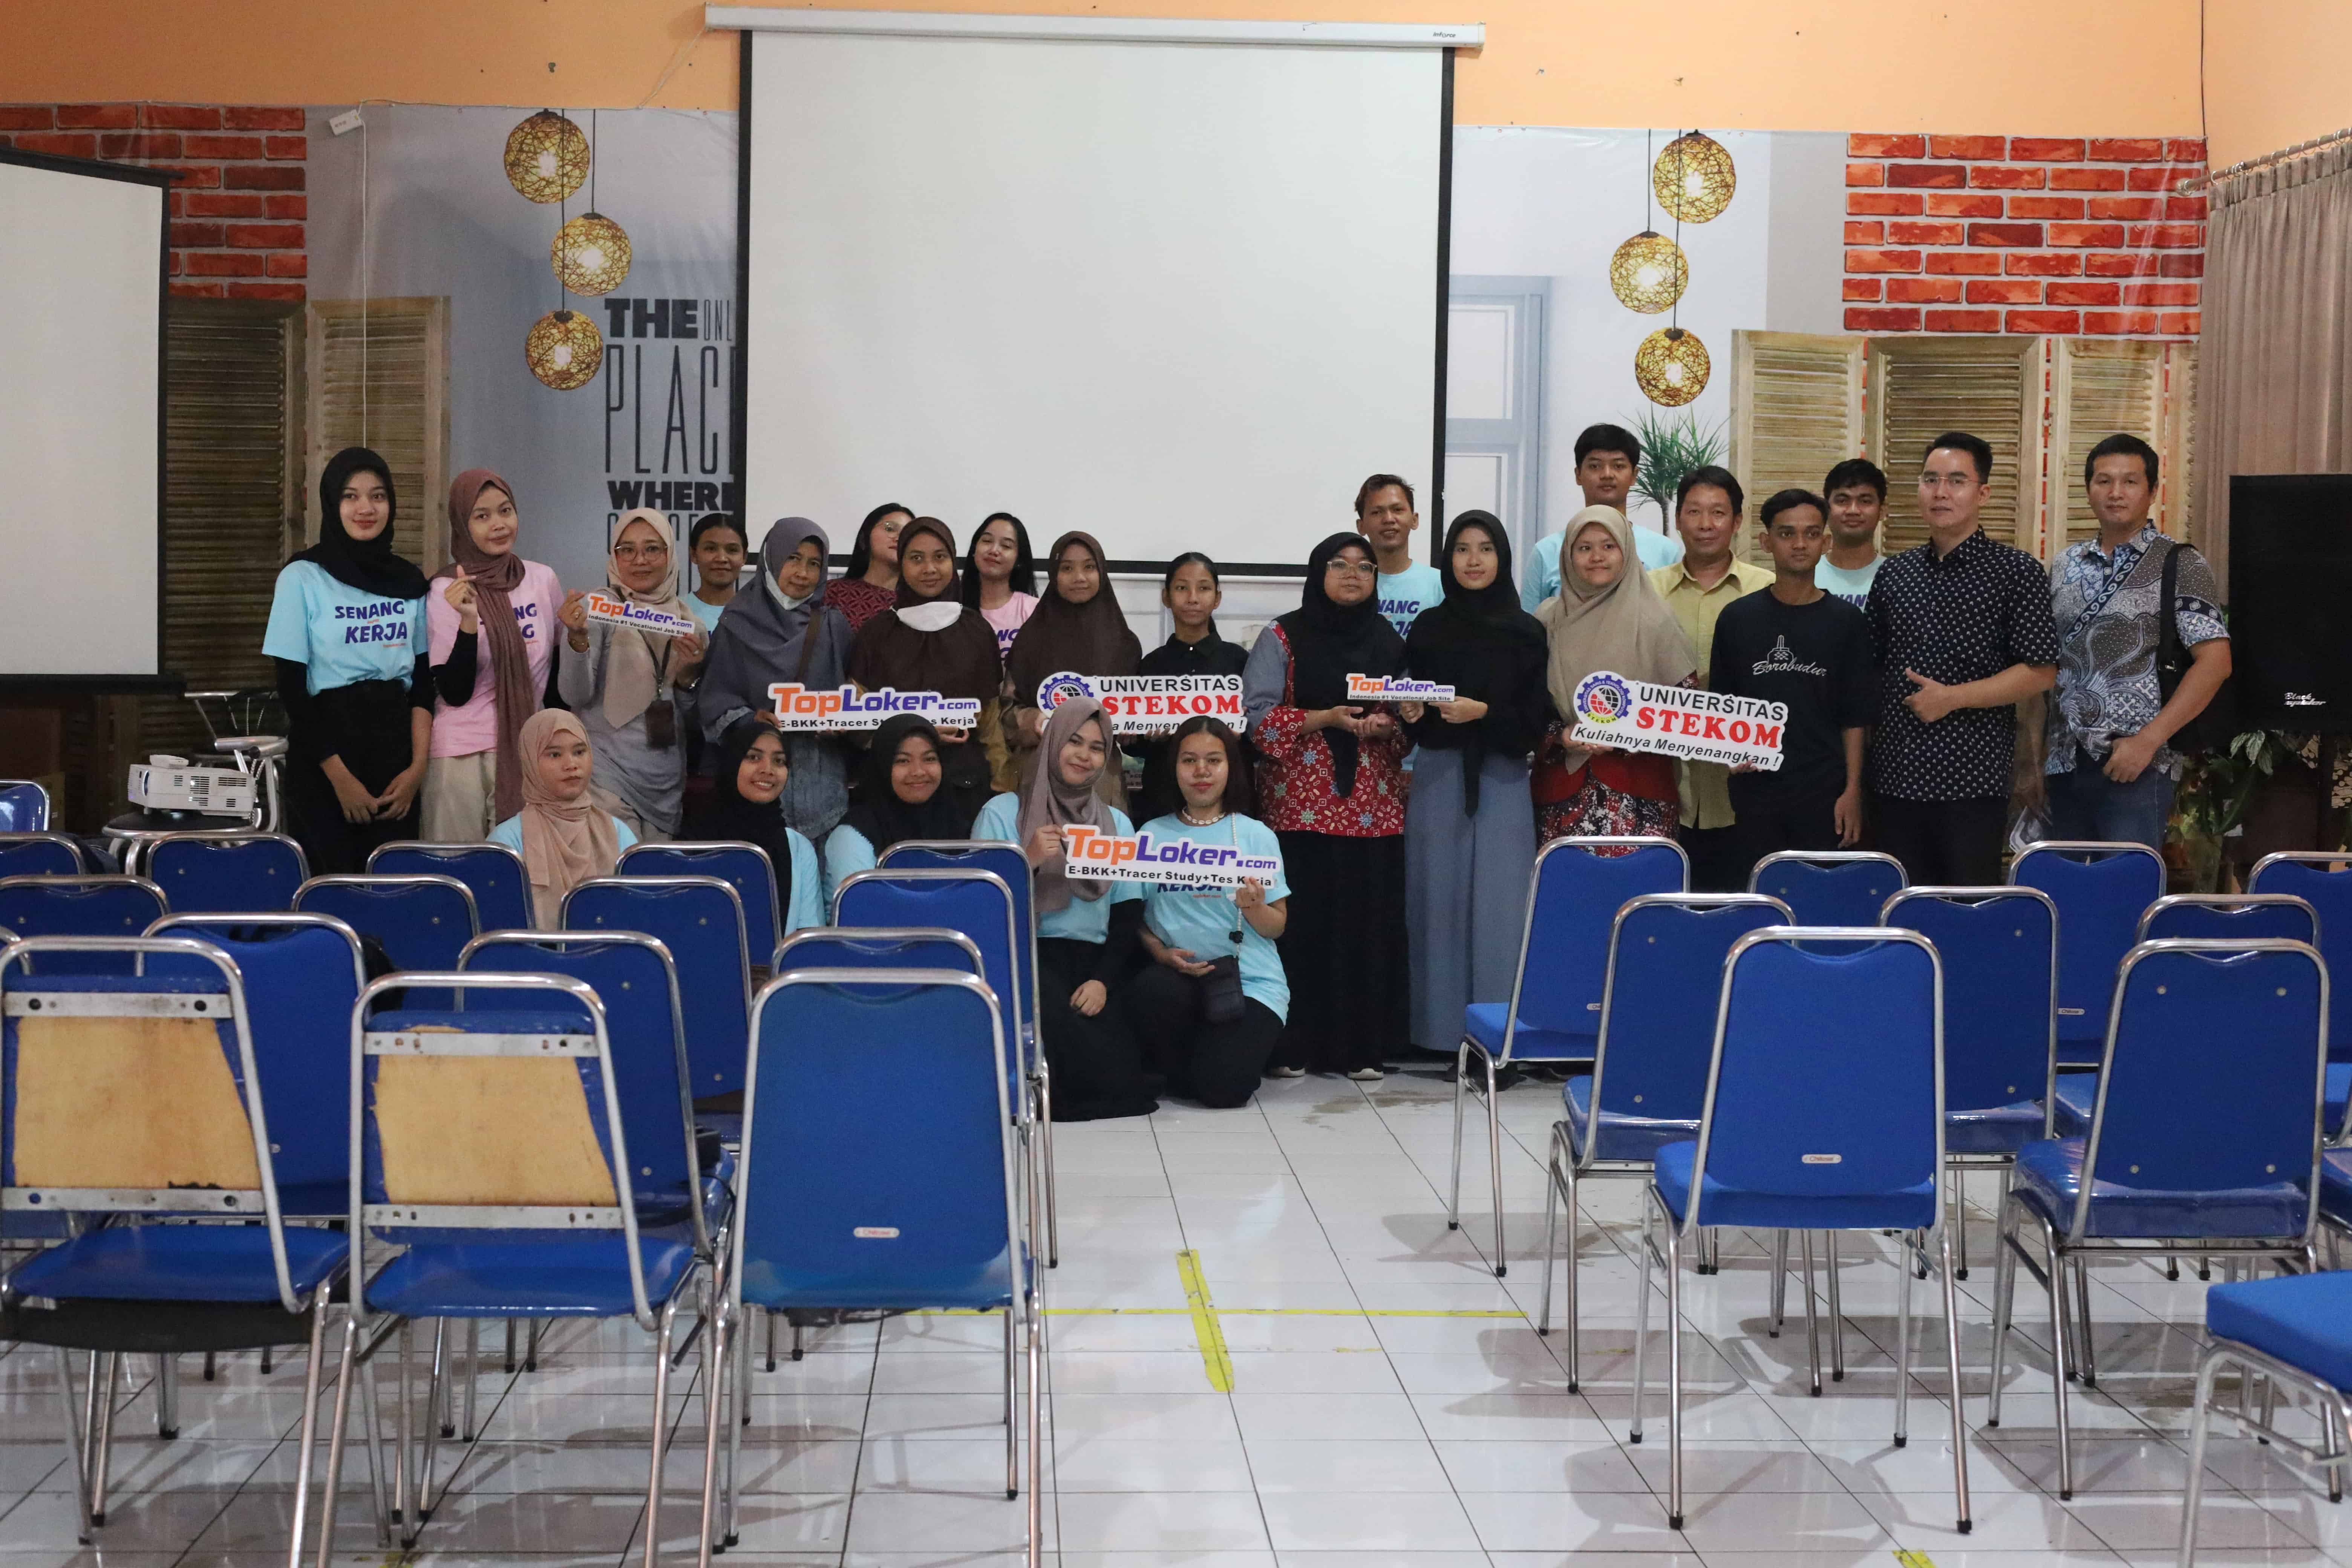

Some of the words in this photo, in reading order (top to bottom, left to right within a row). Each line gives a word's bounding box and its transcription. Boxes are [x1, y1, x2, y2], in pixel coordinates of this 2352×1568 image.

[605, 298, 697, 338] THE
[704, 299, 732, 341] ONL
[335, 600, 404, 620] SENANG
[590, 596, 692, 628] TopLoker.com
[1378, 599, 1420, 614] NANG
[589, 614, 619, 624] Indonesia
[630, 622, 662, 631] Vocational
[345, 622, 407, 644] KERJA
[1752, 657, 1827, 676] Borobudur
[1100, 678, 1239, 692] UNIVERSITAS
[1350, 677, 1453, 694] TopLoker.com
[774, 688, 977, 717] TopLoker.com
[1102, 695, 1240, 715] STEKOM
[1640, 686, 1784, 721] UNIVERSITAS
[941, 717, 974, 726] Kerja
[1588, 713, 1617, 723] STEKOM
[1636, 706, 1780, 748] STEKOM
[1575, 727, 1650, 749] Kuliahnya
[1654, 738, 1769, 766] Menyenangkan
[1067, 828, 1276, 869] TopLoker.com
